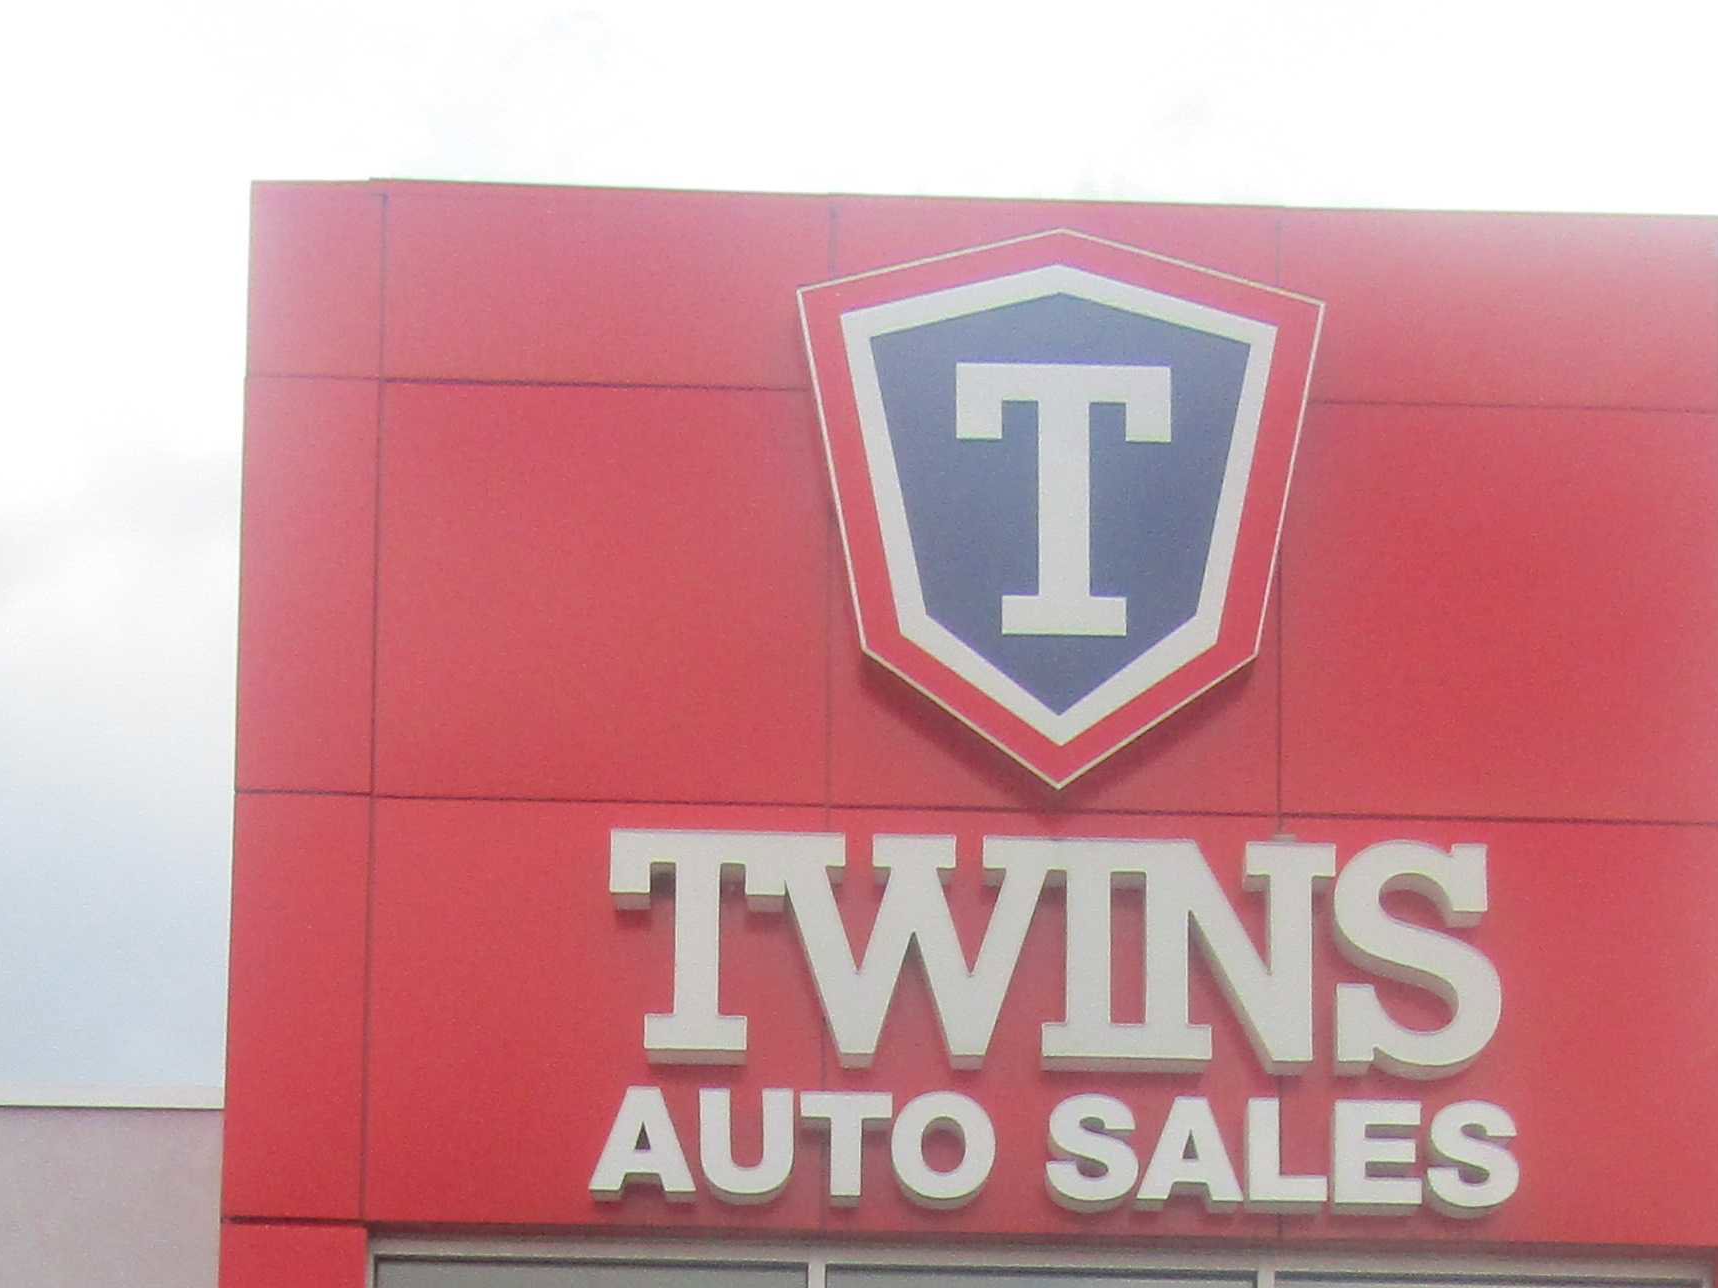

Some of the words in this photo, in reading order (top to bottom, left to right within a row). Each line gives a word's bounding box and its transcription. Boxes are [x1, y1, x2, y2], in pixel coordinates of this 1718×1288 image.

[956, 363, 1171, 636] T
[609, 829, 1503, 1075] TWINS
[591, 1087, 994, 1209] AUTO
[1045, 1096, 1520, 1216] SALES
